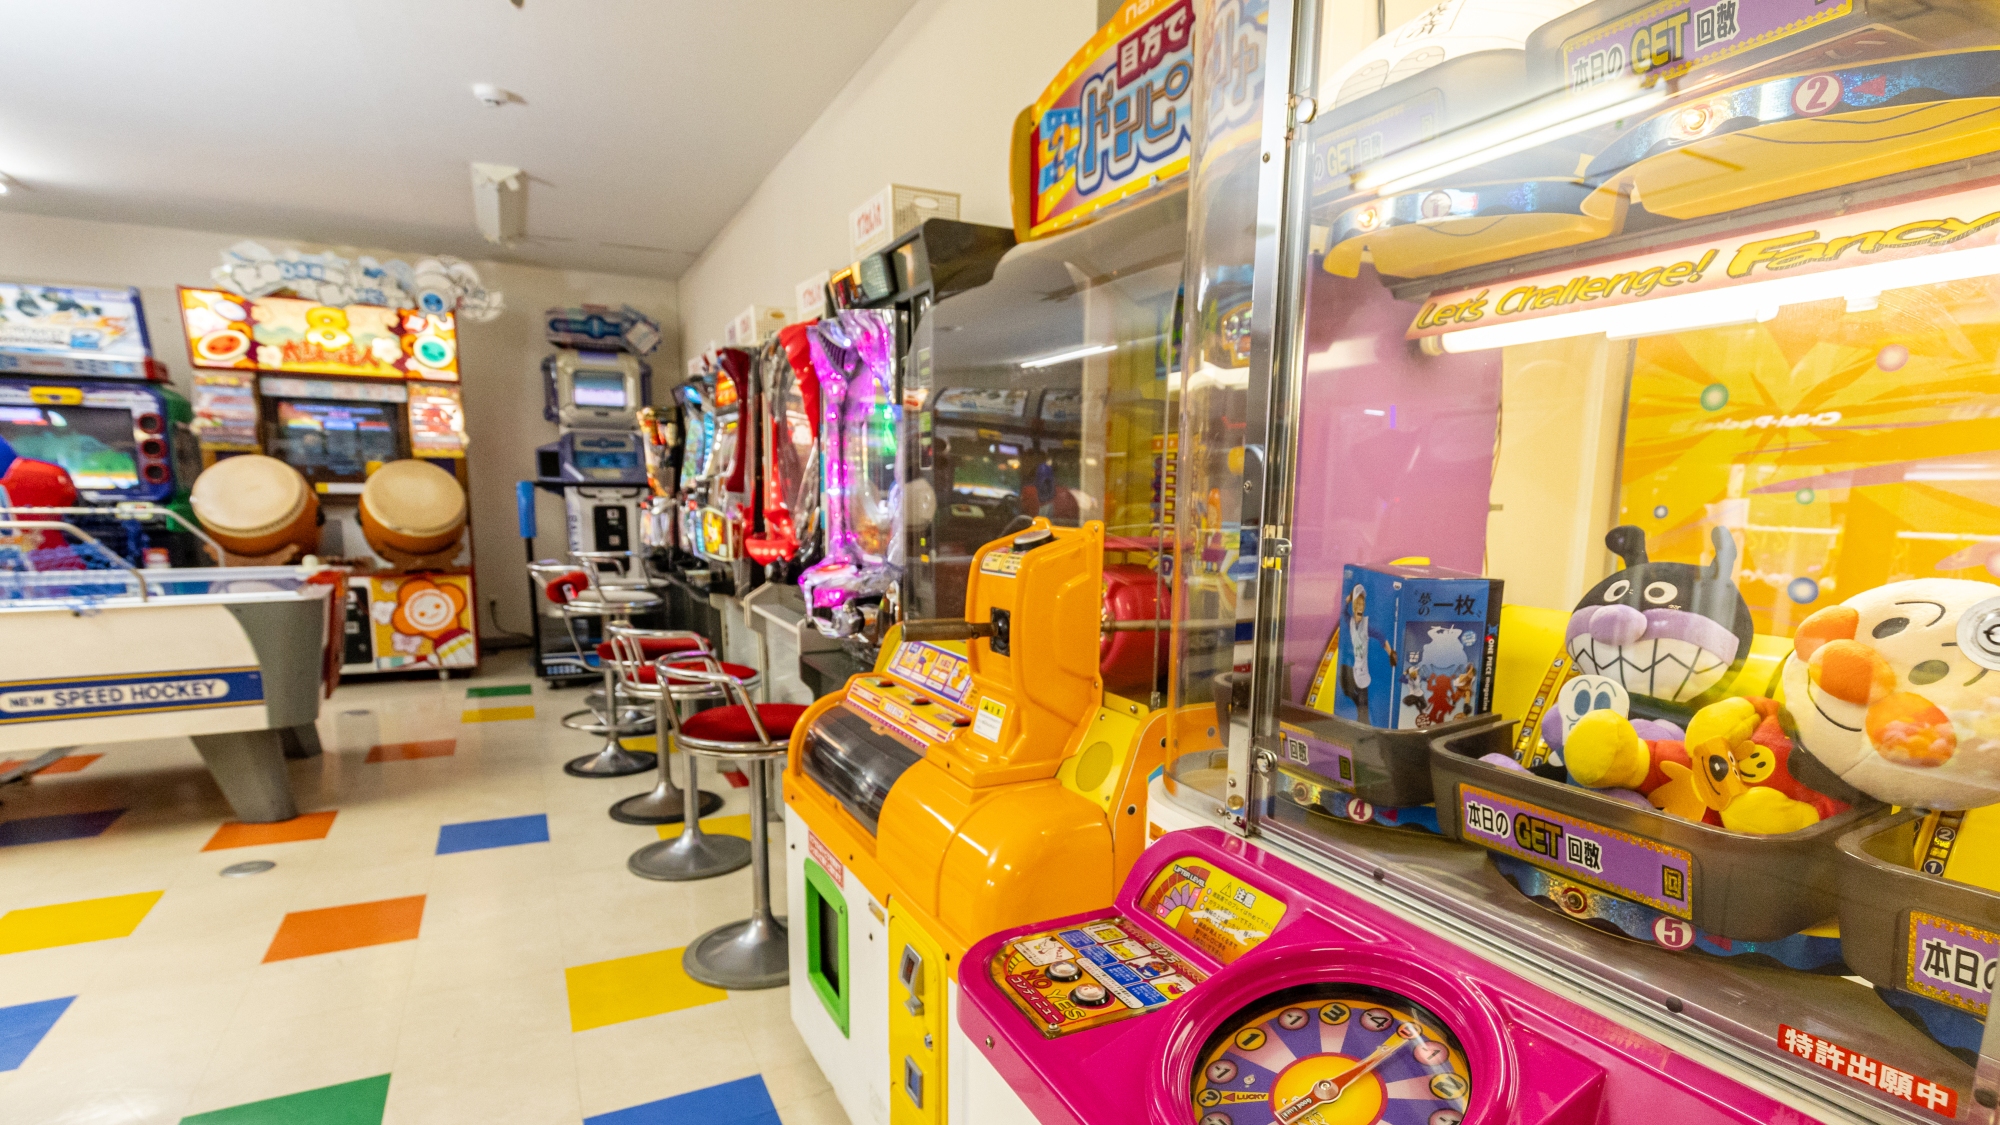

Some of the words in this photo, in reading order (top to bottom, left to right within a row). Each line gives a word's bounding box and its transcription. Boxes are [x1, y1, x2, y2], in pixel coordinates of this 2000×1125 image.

[1121, 6, 1187, 77] 目方で
[1573, 46, 1623, 91] 本日の
[1630, 8, 1691, 75] GET
[1696, 0, 1738, 49] 回数
[1806, 77, 1829, 111] 2
[1327, 138, 1357, 177] GET
[1416, 289, 1489, 330] Let's
[1495, 249, 1719, 316] Challenge!
[1726, 211, 2000, 279] Fancy
[1487, 638, 1495, 653] ONE
[1484, 656, 1493, 675] PIECE
[9, 696, 45, 708] NEW
[52, 689, 124, 708] SPEED
[130, 679, 217, 700] HOCKEY
[1482, 677, 1491, 711] magazine
[1353, 799, 1366, 820] 4
[1468, 803, 1510, 837] 本日の
[1513, 812, 1563, 860] GET
[1567, 835, 1601, 870] 回数
[1662, 865, 1684, 902] 回
[1173, 864, 1191, 879] LIFTER
[1190, 872, 1206, 888] LEVEL
[1664, 918, 1684, 947] 5
[1021, 968, 1053, 990] NO
[1010, 976, 1060, 1022] コンティニュー
[1047, 988, 1087, 1021] YES
[1784, 1027, 1949, 1110] 特許出願中
[1236, 1092, 1267, 1100] LUCKY
